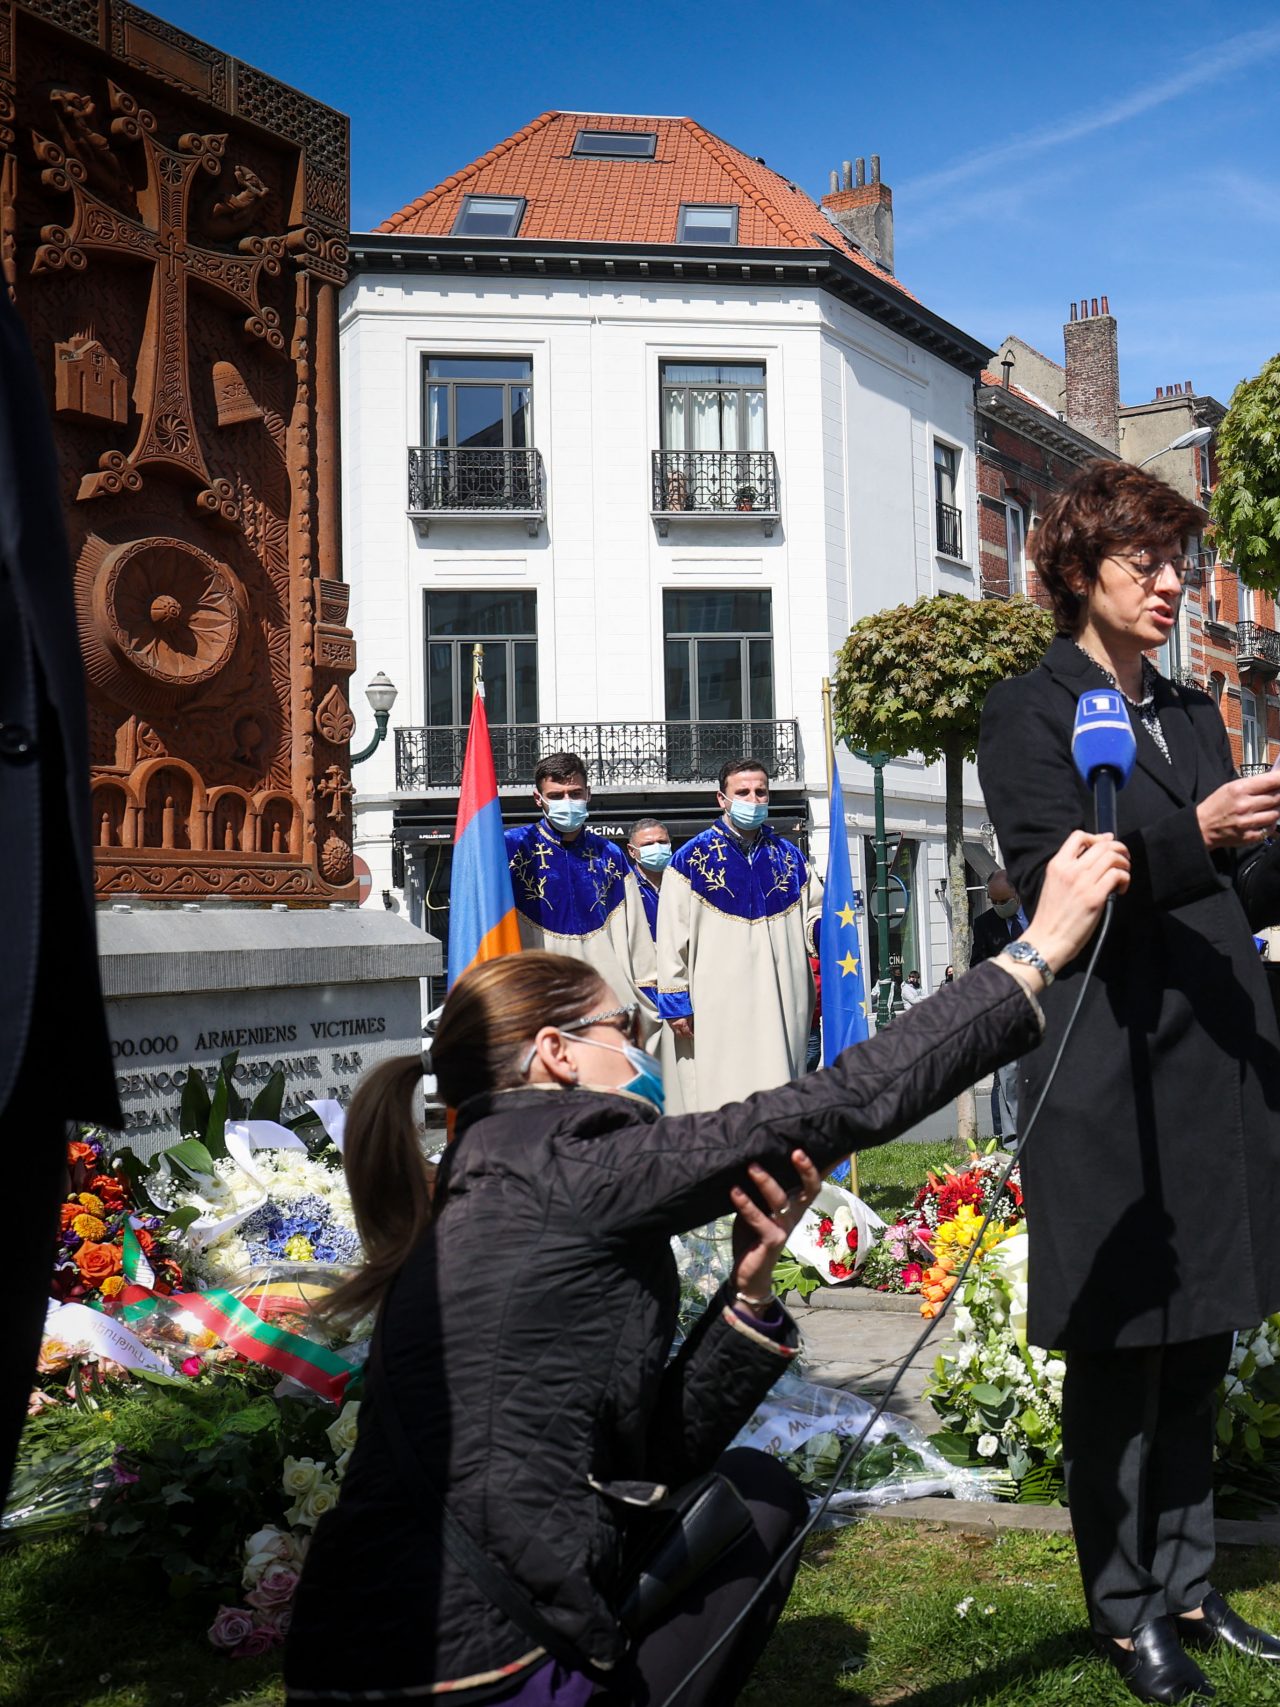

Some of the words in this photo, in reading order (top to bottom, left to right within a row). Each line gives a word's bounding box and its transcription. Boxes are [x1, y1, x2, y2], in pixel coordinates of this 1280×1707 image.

[111, 1035, 178, 1058] 00.000
[195, 1025, 297, 1050] ARMENIENS
[310, 1017, 386, 1040] VICTIMES
[332, 1052, 363, 1069] PAR
